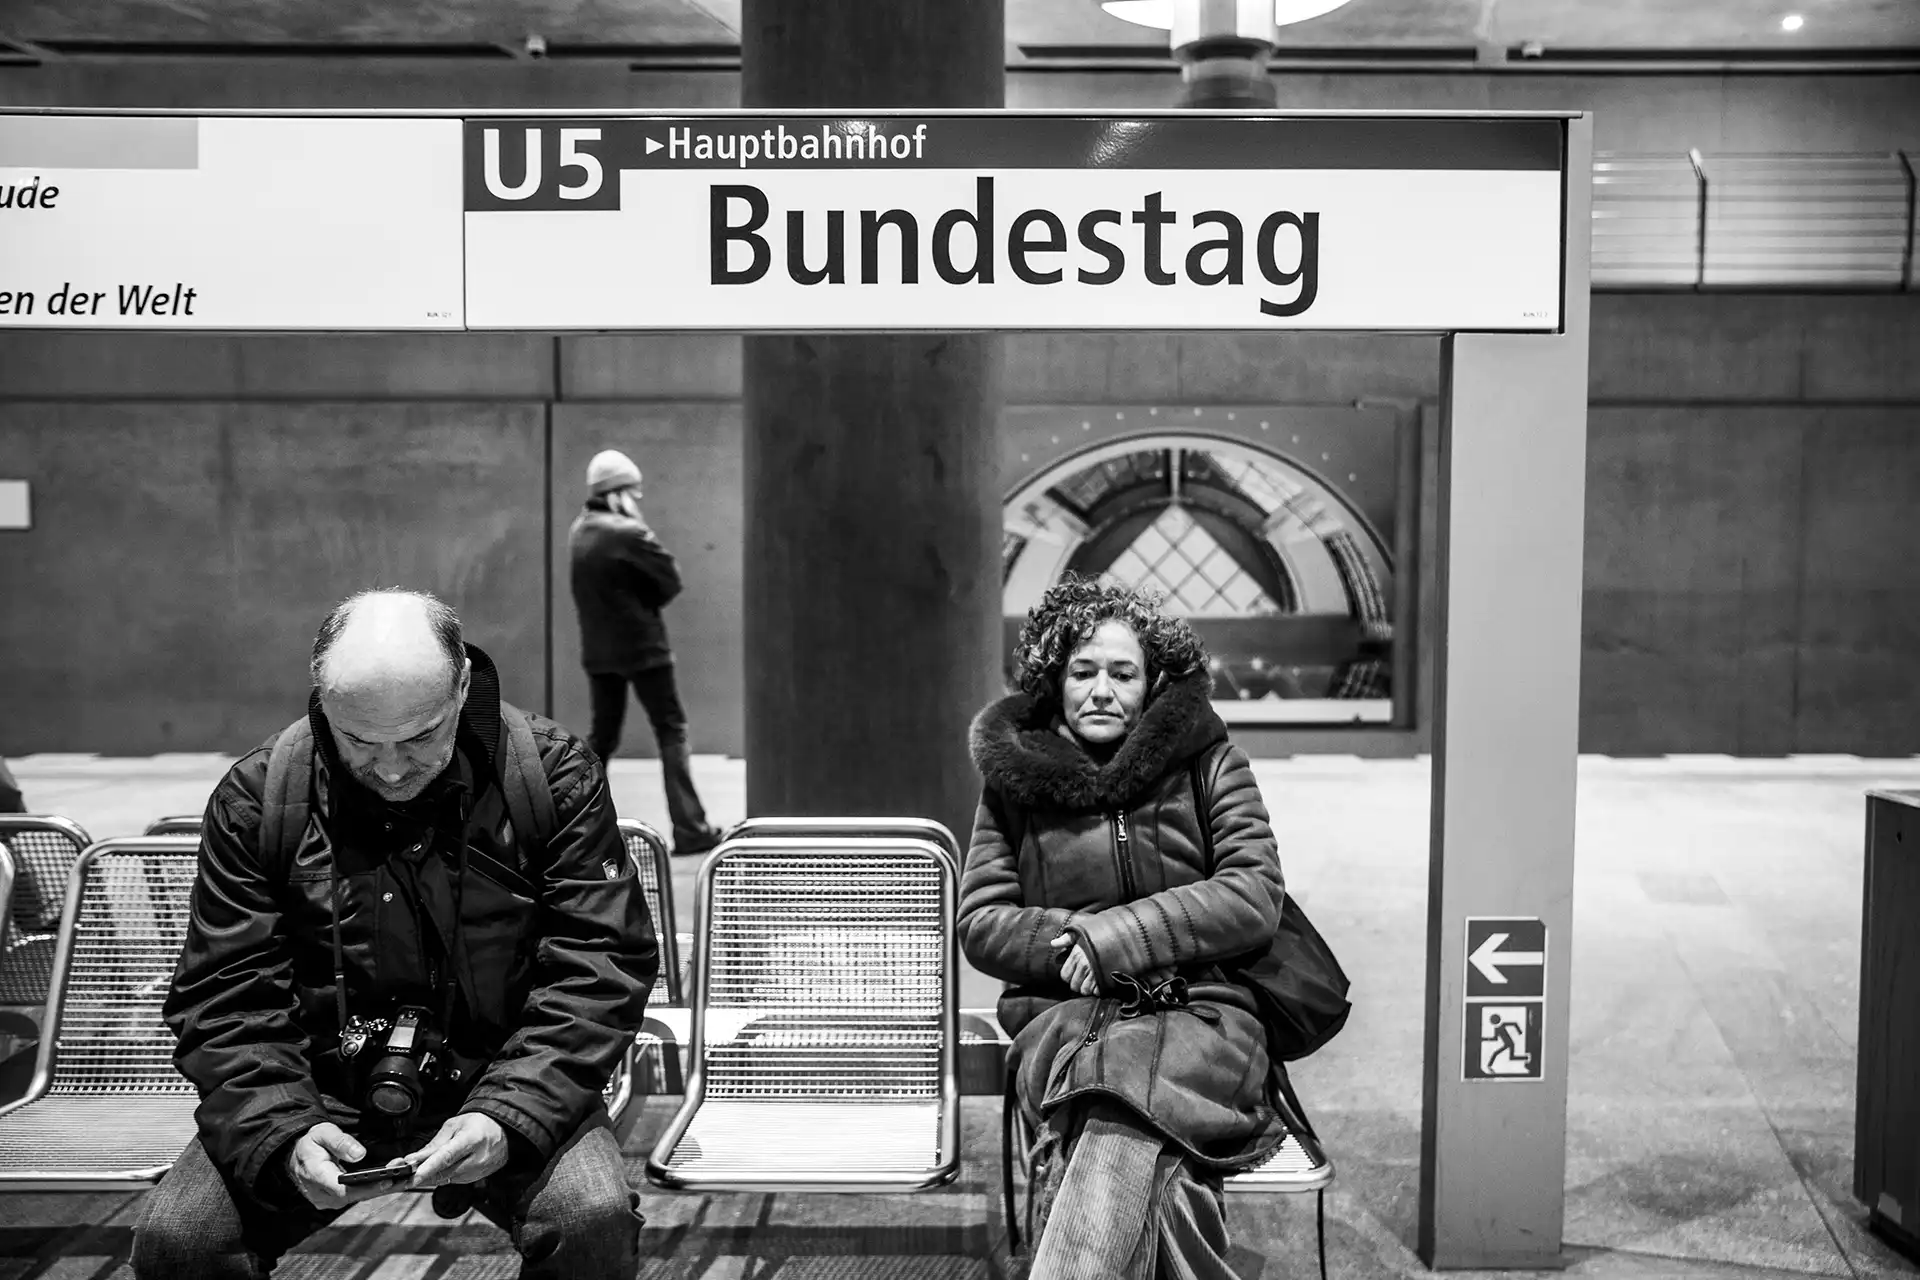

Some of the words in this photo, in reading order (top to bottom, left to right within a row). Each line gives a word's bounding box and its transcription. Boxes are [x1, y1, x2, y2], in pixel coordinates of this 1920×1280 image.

[668, 124, 928, 168] Hauptbahnhof
[708, 176, 1321, 319] Bundestag
[47, 281, 107, 316] der
[118, 282, 198, 316] Welt
